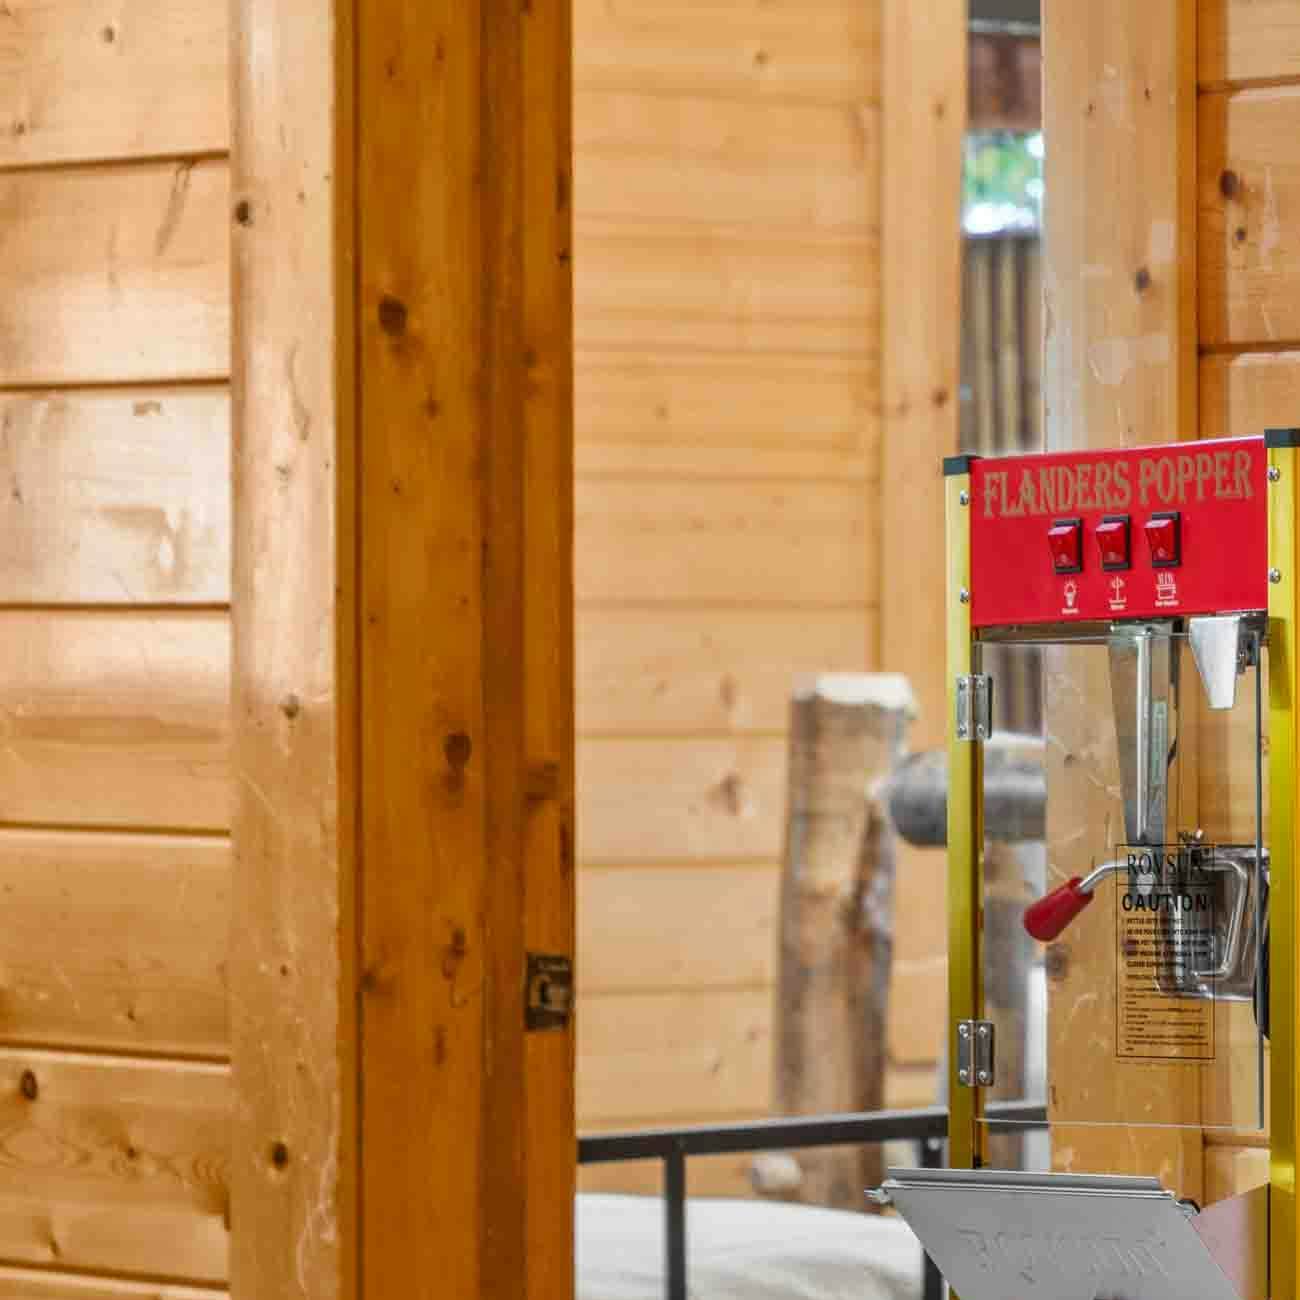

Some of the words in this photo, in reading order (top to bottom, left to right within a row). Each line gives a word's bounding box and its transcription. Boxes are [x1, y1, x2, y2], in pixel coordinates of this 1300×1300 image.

[983, 459, 1133, 518] FLANDERS
[1137, 450, 1254, 505] POPPER
[1122, 893, 1208, 913] CAUTION
